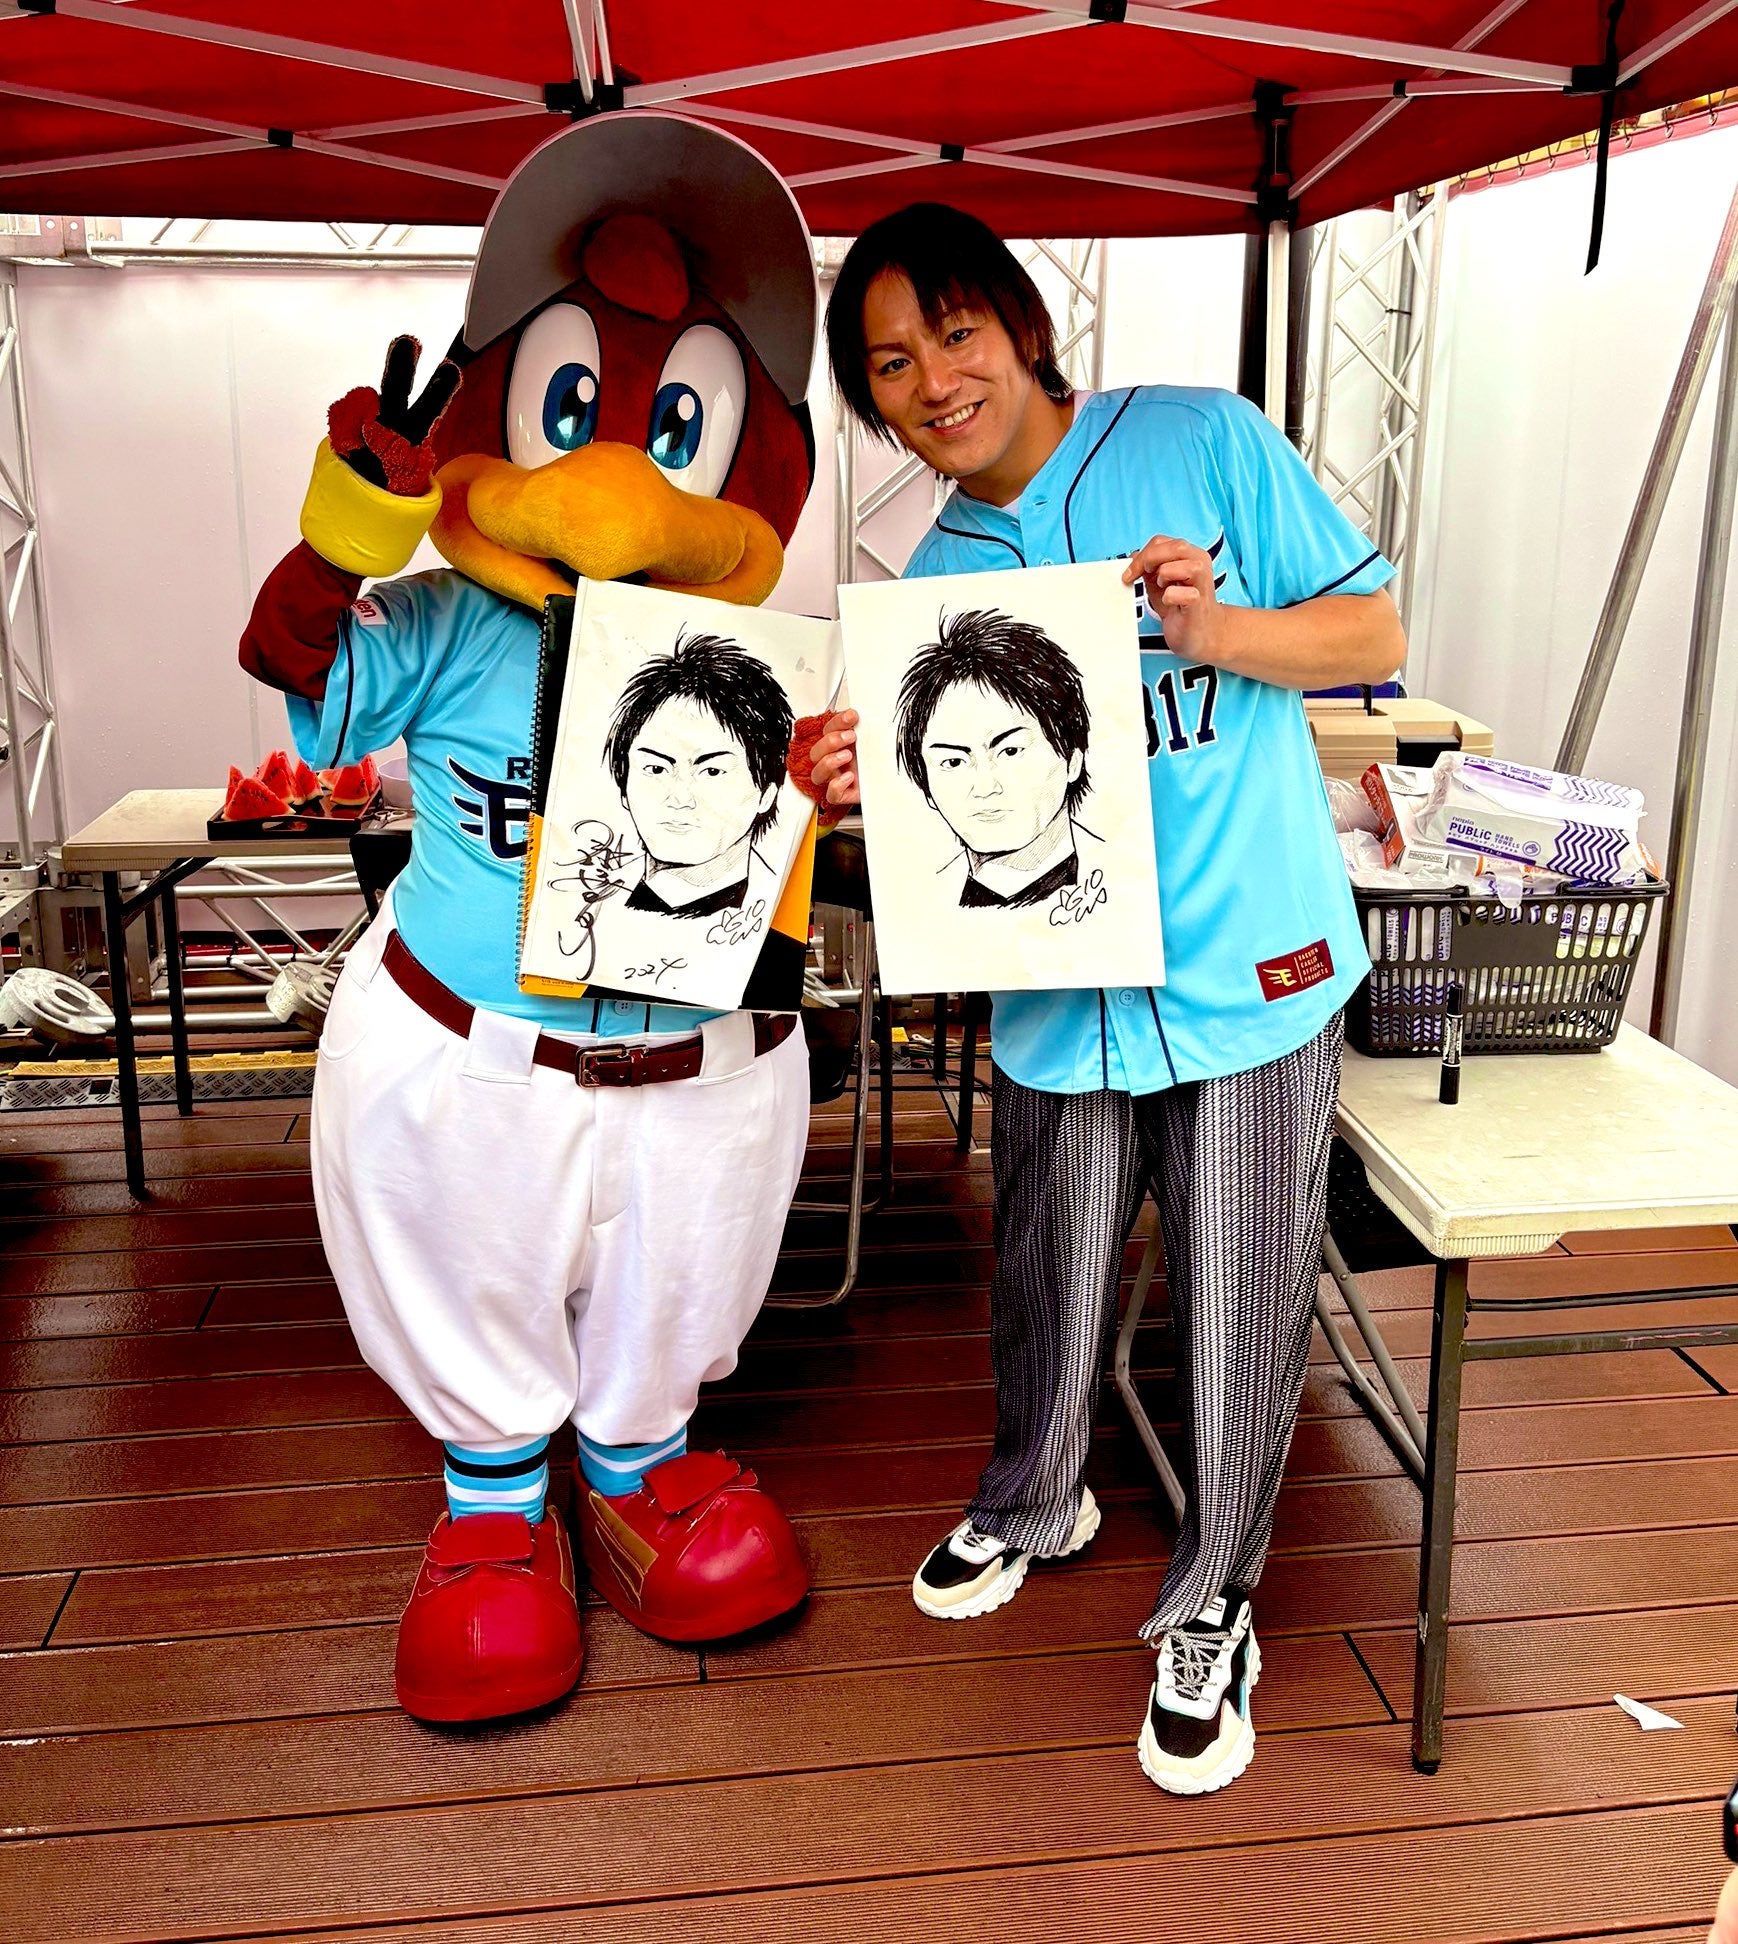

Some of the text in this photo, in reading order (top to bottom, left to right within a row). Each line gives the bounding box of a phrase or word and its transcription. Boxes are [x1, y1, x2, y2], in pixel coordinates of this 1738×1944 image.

[506, 757, 532, 780] R
[1495, 833, 1514, 841] HAND
[1494, 838, 1520, 849] TOWELS
